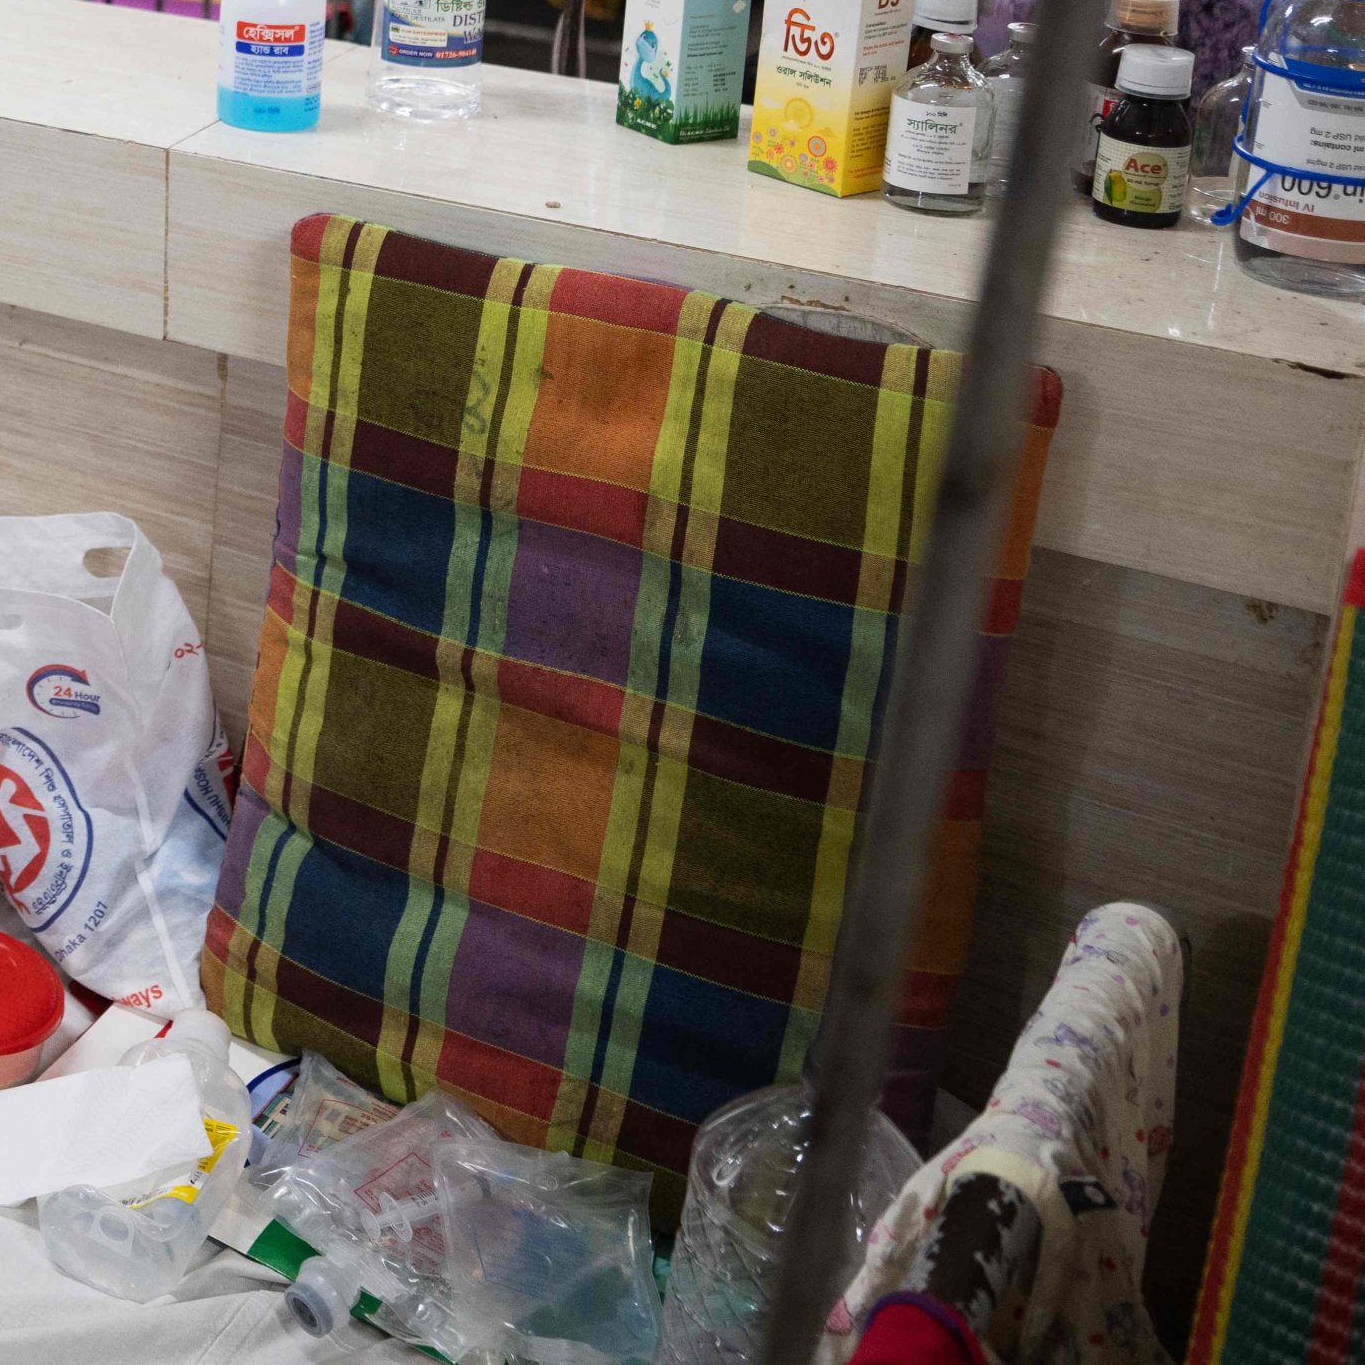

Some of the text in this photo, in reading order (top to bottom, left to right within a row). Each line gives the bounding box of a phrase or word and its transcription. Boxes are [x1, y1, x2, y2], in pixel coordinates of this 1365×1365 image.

[243, 24, 294, 42] হেক্সিসল
[783, 7, 835, 61] ডি৩
[776, 65, 797, 78] ওরাল
[799, 70, 832, 88] সলিউশন
[907, 118, 958, 134] স্যালিনর
[1310, 127, 1323, 136] mg
[1333, 131, 1352, 139] USP
[1310, 140, 1351, 152] contains:
[1124, 158, 1163, 175] Ace
[1258, 190, 1315, 213] IV Infusion
[1256, 205, 1290, 225] 300 ml
[53, 685, 101, 702] 24 Hour
[39, 767, 56, 793] শিশু
[53, 793, 73, 846] হাসপাতাল
[62, 851, 72, 860] ও
[55, 900, 109, 963] Dhaka 1207
